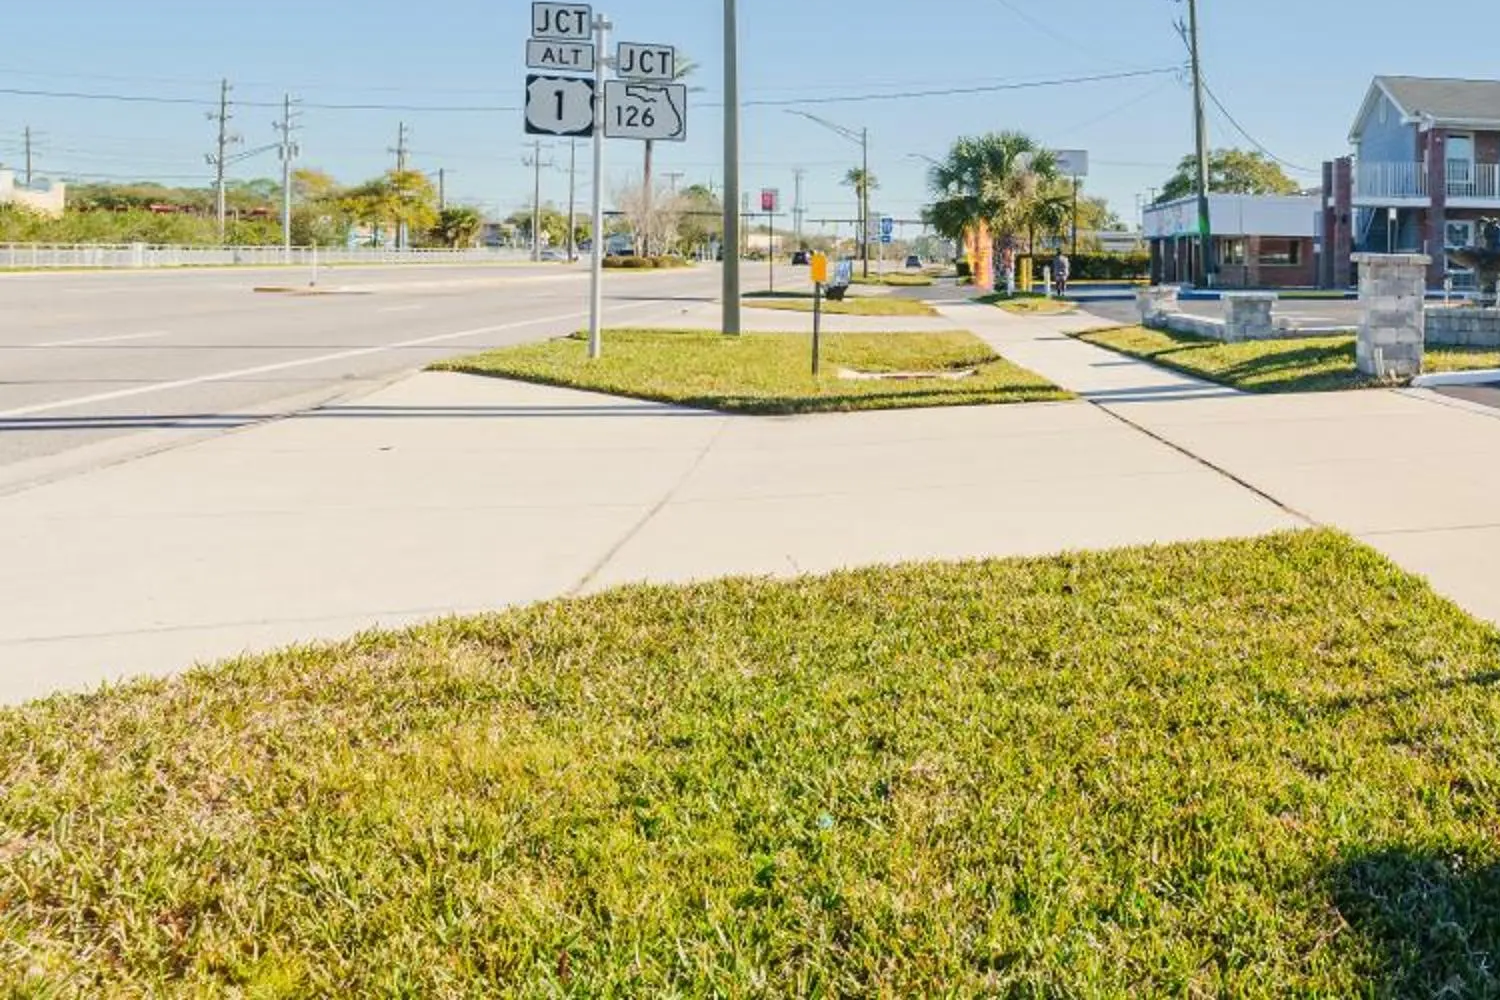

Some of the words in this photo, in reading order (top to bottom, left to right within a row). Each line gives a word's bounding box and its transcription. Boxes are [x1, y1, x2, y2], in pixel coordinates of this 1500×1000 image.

[536, 9, 587, 34] JCT
[541, 48, 582, 65] ALT
[621, 49, 670, 75] JCT
[554, 89, 564, 121] 1
[616, 105, 655, 128] 126
